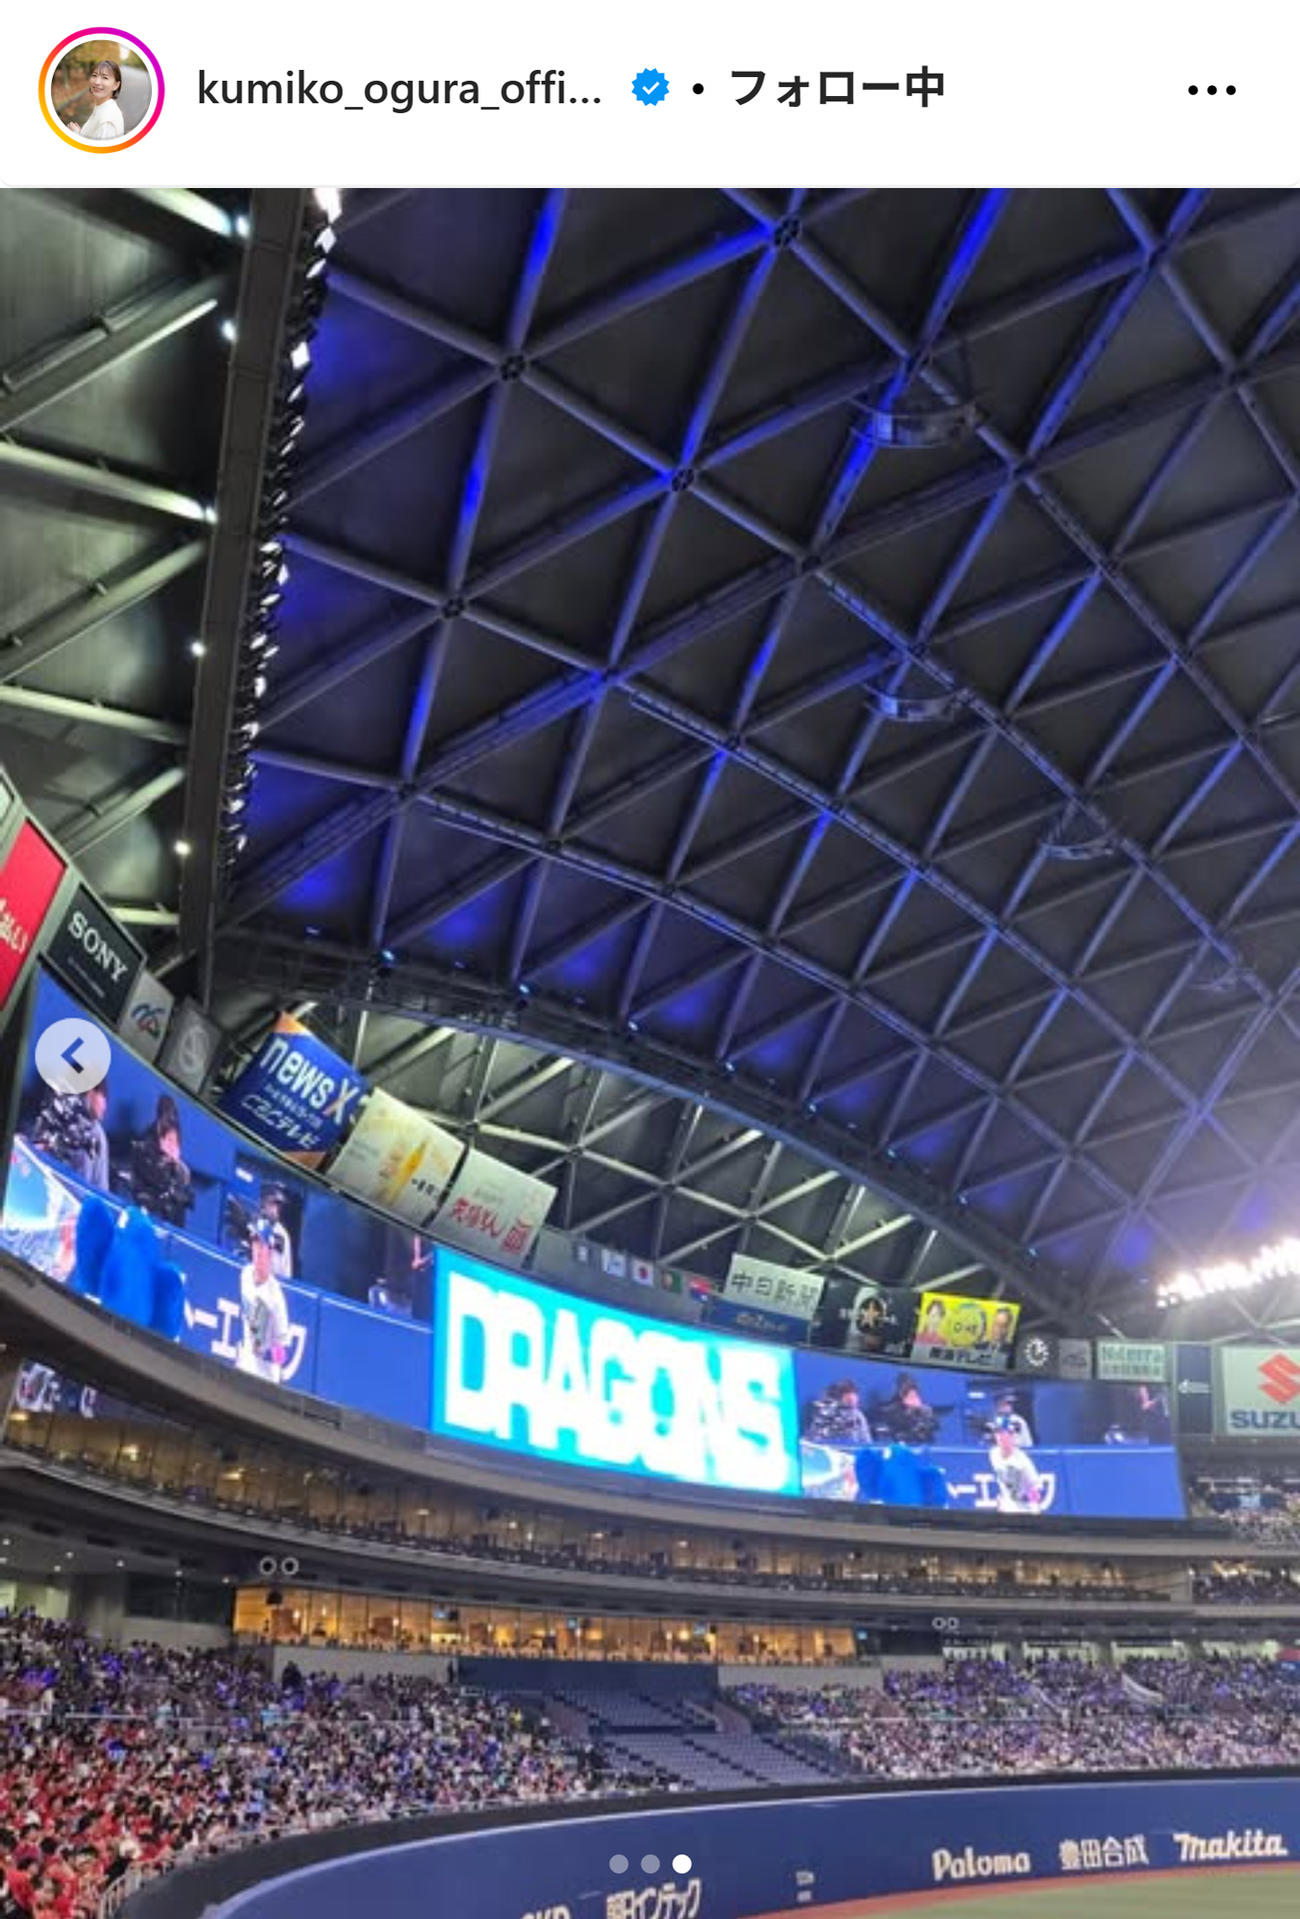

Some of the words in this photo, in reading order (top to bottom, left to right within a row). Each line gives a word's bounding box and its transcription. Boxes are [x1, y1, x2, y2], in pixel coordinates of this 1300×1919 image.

[67, 911, 128, 982] SONY
[445, 1271, 788, 1492] DRAGONS
[932, 1847, 1031, 1881] Paloma
[1059, 1833, 1149, 1870] 豊田合成
